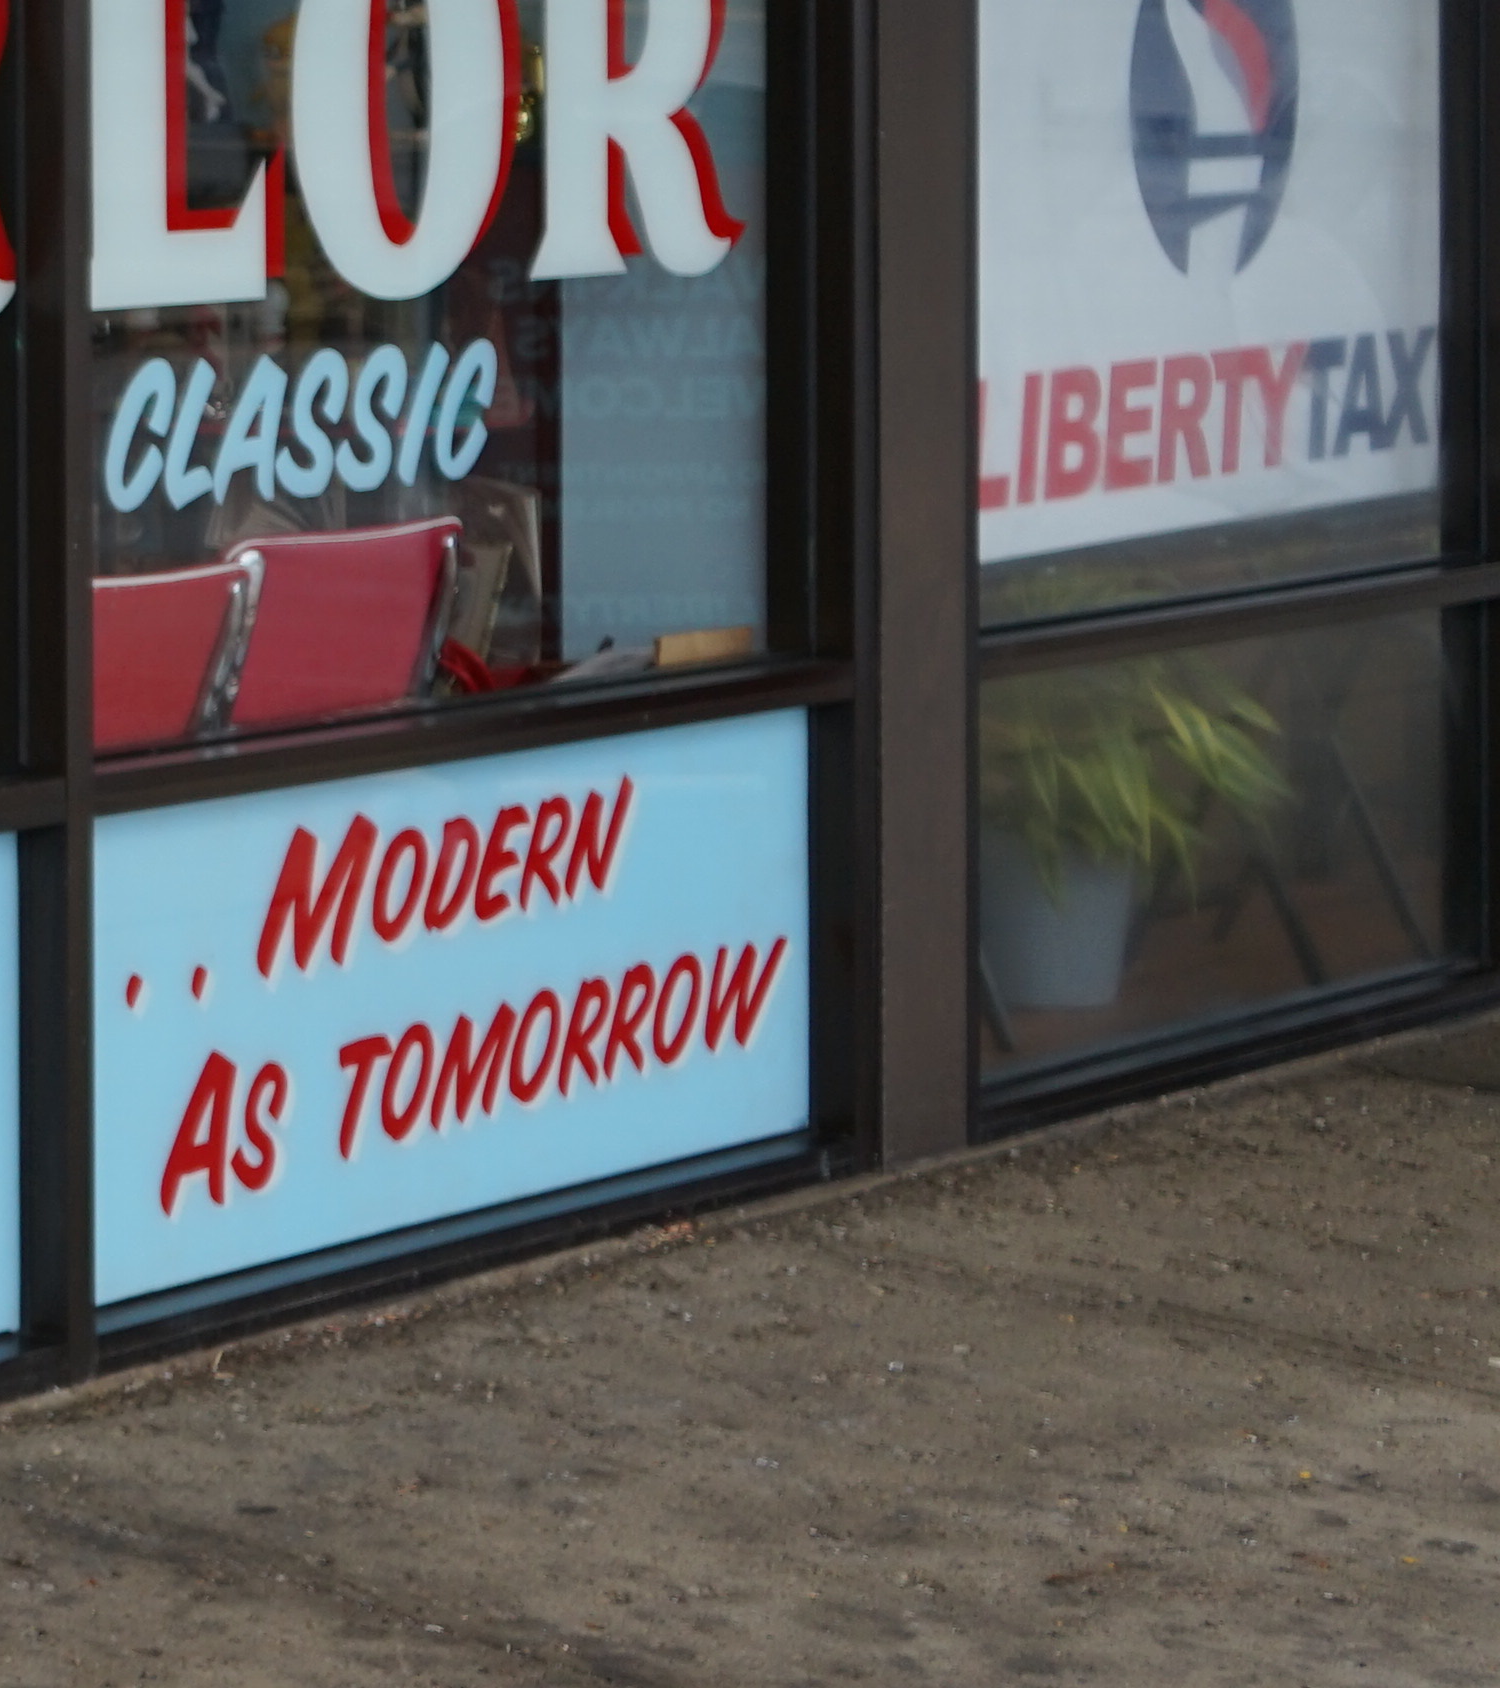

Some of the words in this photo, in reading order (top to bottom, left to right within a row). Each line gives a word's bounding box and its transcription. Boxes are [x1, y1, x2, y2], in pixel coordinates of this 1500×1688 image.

[105, 339, 497, 511] CLASSIC
[979, 326, 1436, 510] LIBERTYTAX
[256, 773, 634, 982] MODERN
[160, 1049, 288, 1220] AS
[339, 935, 789, 1163] TOMORROW
